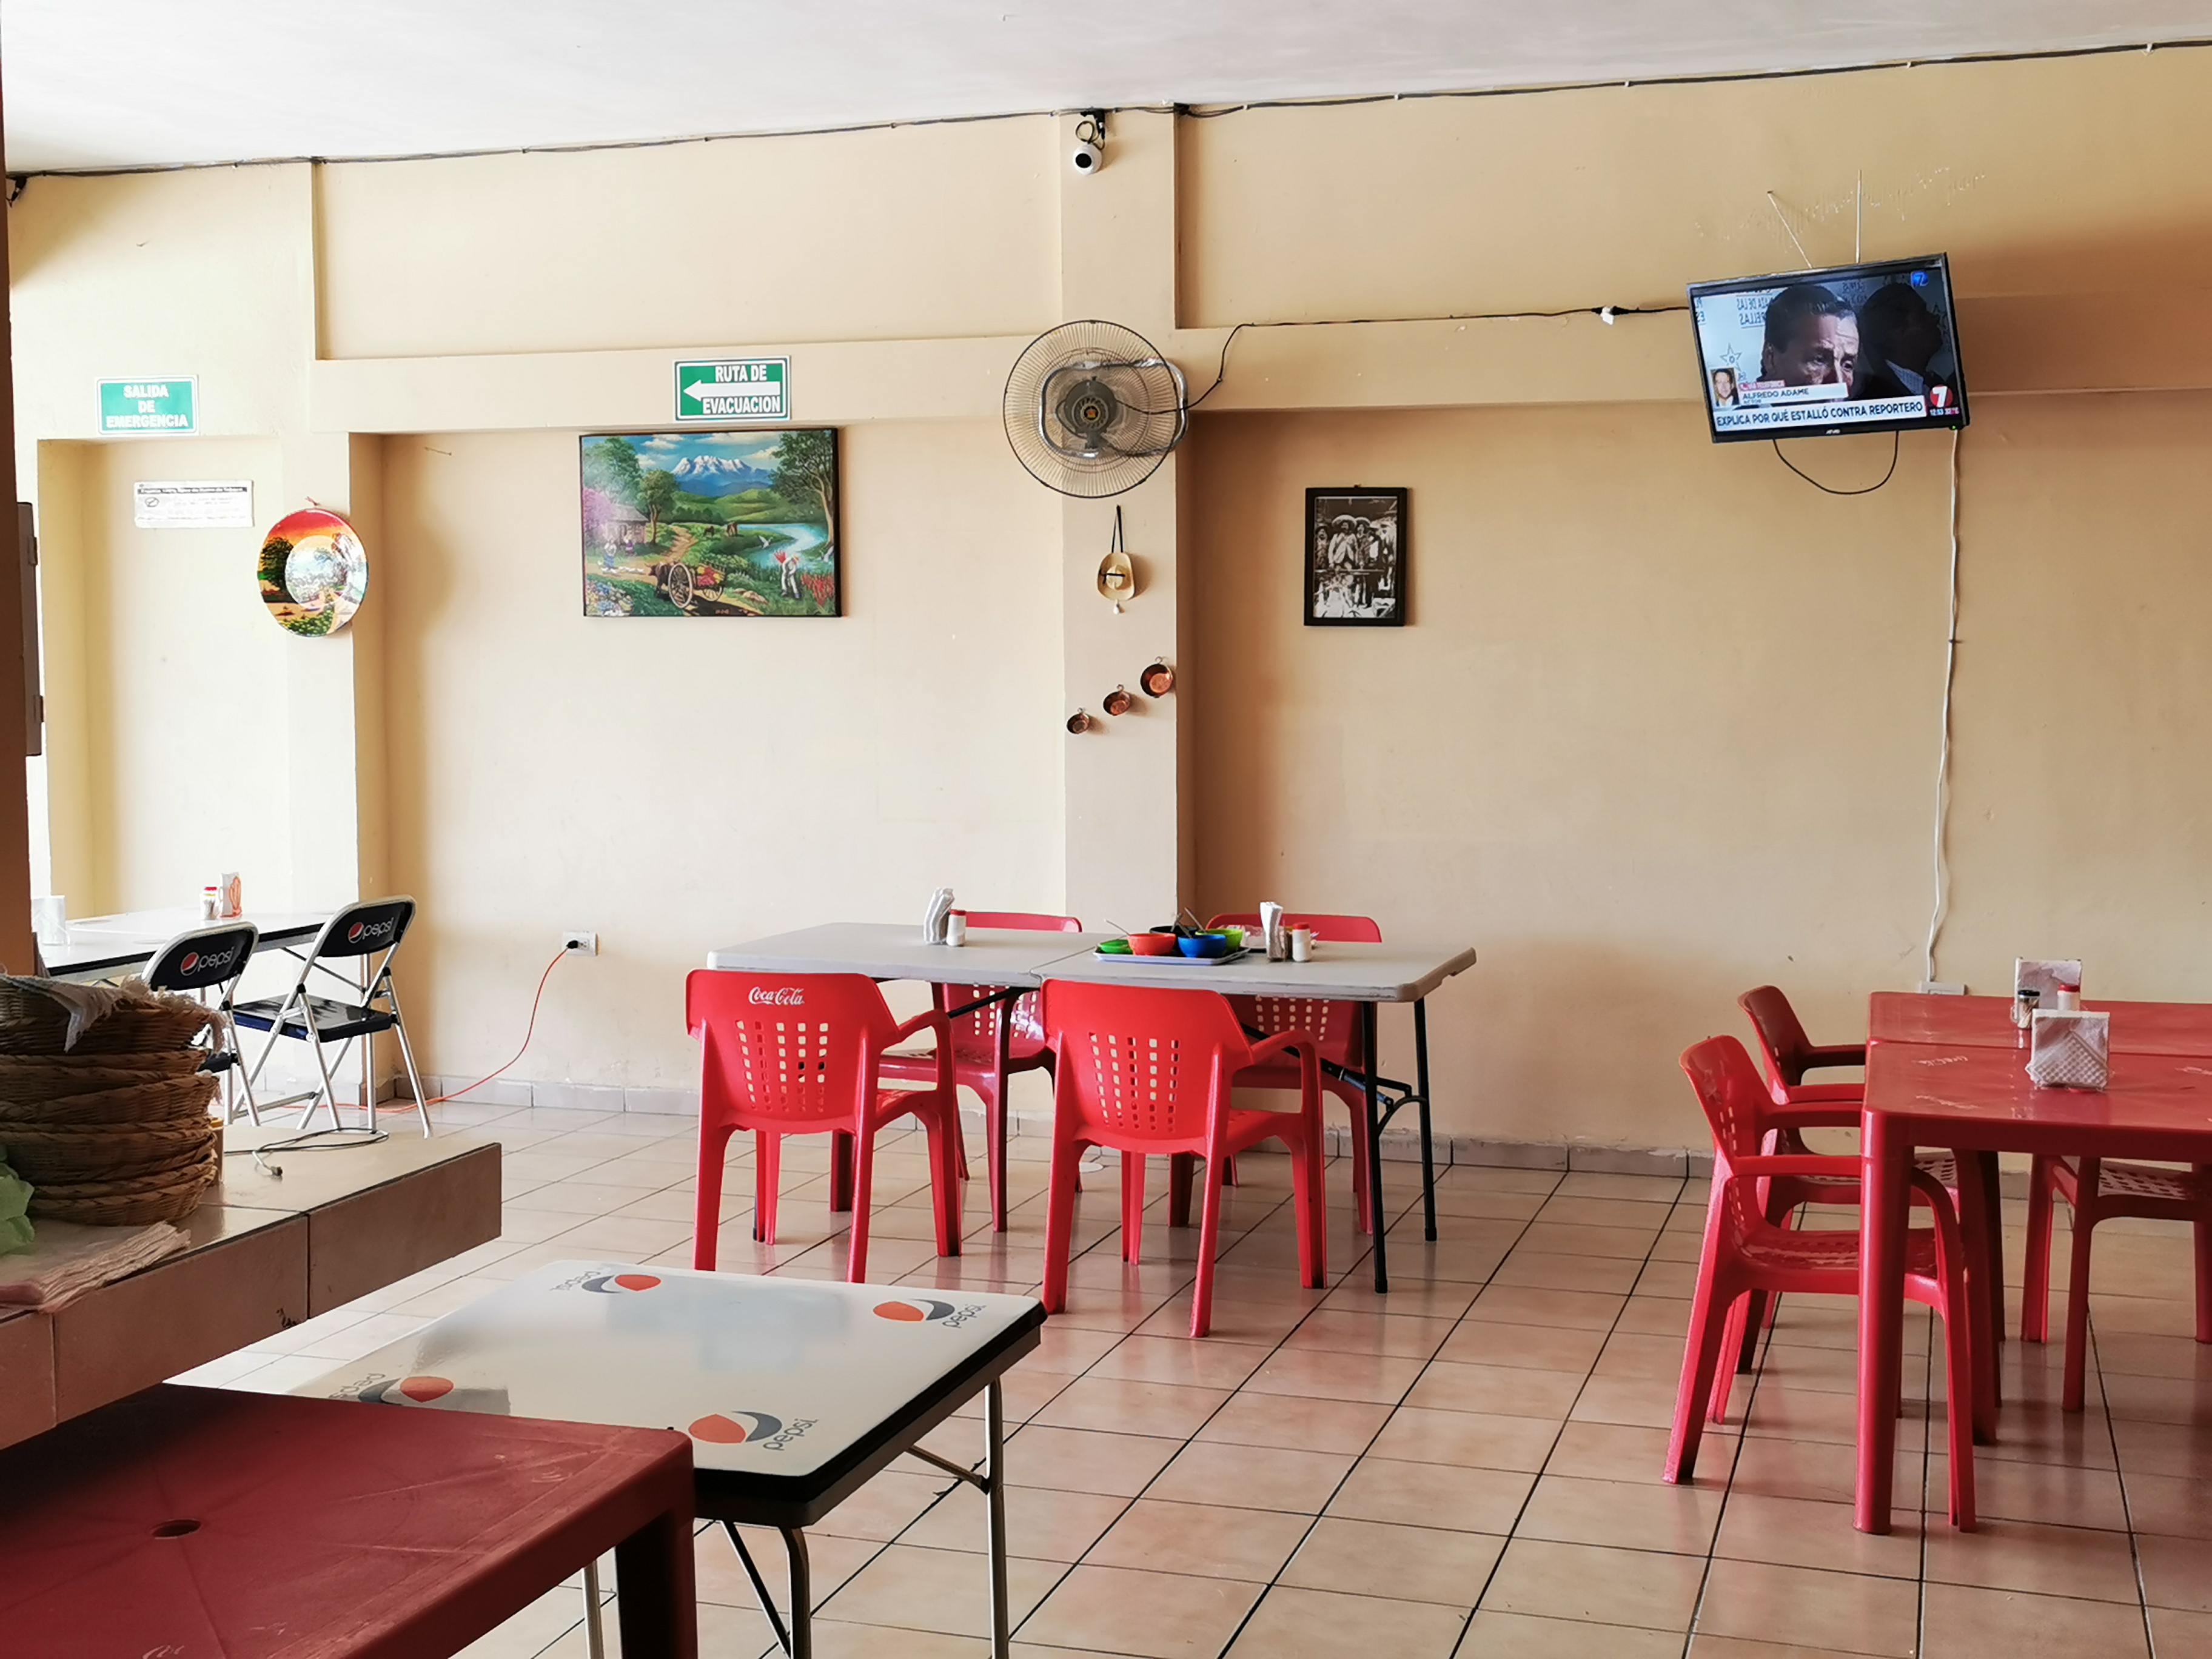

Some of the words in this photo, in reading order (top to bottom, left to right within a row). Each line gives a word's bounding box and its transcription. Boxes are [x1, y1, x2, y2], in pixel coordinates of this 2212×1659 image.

[715, 366, 748, 382] RUTA
[751, 364, 767, 381] DE
[123, 384, 169, 398] SALIDA
[1742, 390, 1779, 400] ALFREDO
[1780, 388, 1809, 397] ADAME
[1932, 386, 1948, 407] 7
[138, 400, 156, 414] DE
[703, 396, 780, 414] EVACUACION
[1716, 415, 1750, 426] EXPLICA
[1752, 414, 1769, 424] POR
[1772, 409, 1789, 423] QUÉ
[1791, 406, 1829, 421] ESTALLÓ
[1830, 404, 1868, 417] CONTRA
[1869, 401, 1923, 414] REPORTERO
[106, 414, 189, 428] EMERGENCIA
[363, 916, 394, 940] pepsi
[197, 946, 235, 973] pepsi
[748, 986, 805, 1006] Coca-Cola
[549, 1271, 602, 1292] pepsi
[941, 1302, 987, 1329] pepsi
[328, 1373, 386, 1399] peps
[762, 1417, 819, 1452] pepsi
